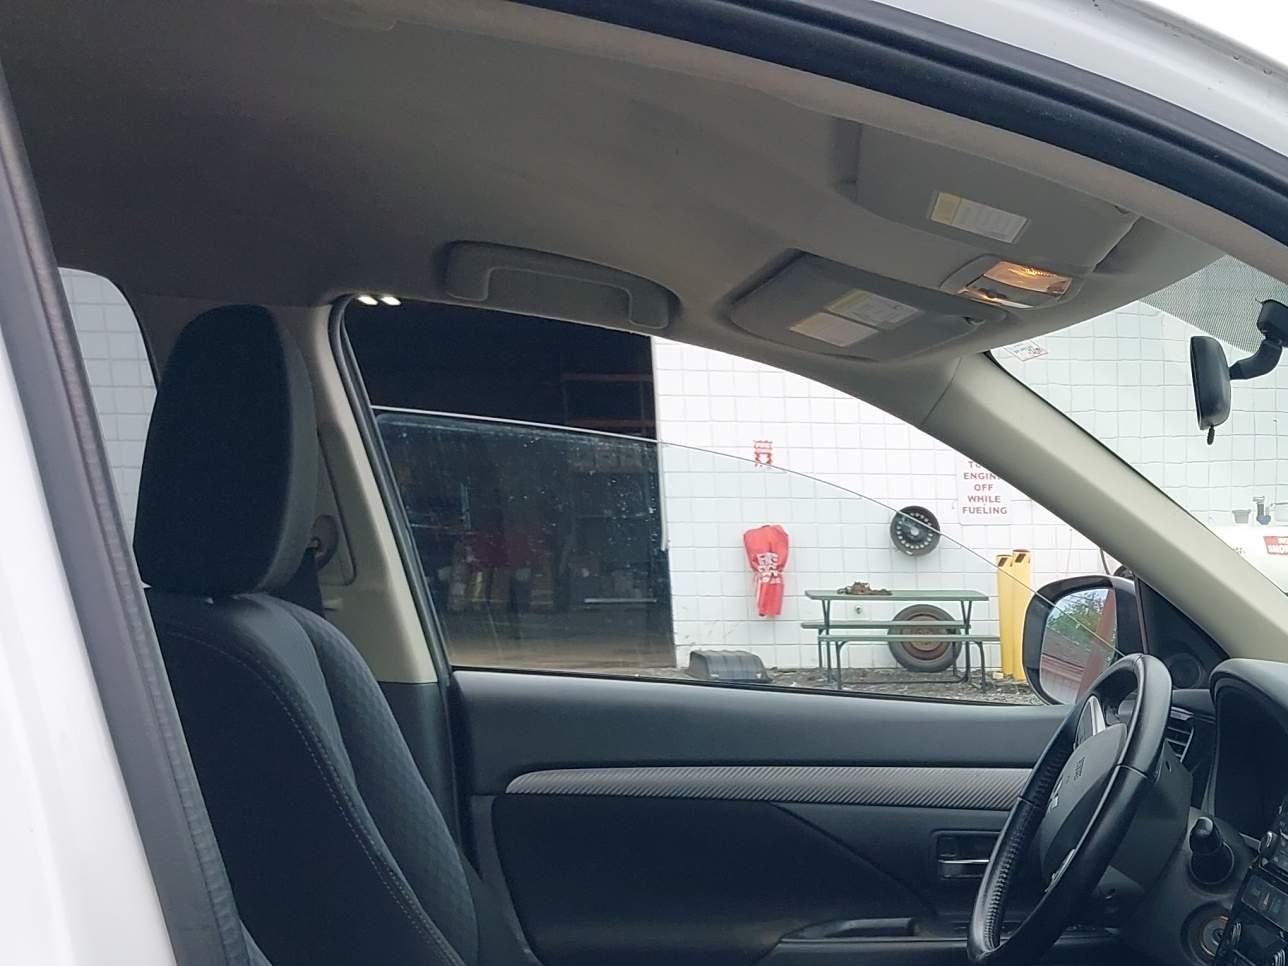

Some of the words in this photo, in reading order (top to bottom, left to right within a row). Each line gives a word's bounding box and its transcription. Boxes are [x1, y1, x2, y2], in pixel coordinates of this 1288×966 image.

[963, 472, 1000, 480] ENGIN
[967, 495, 1001, 503] WHILE
[962, 506, 1008, 515] FUELING
